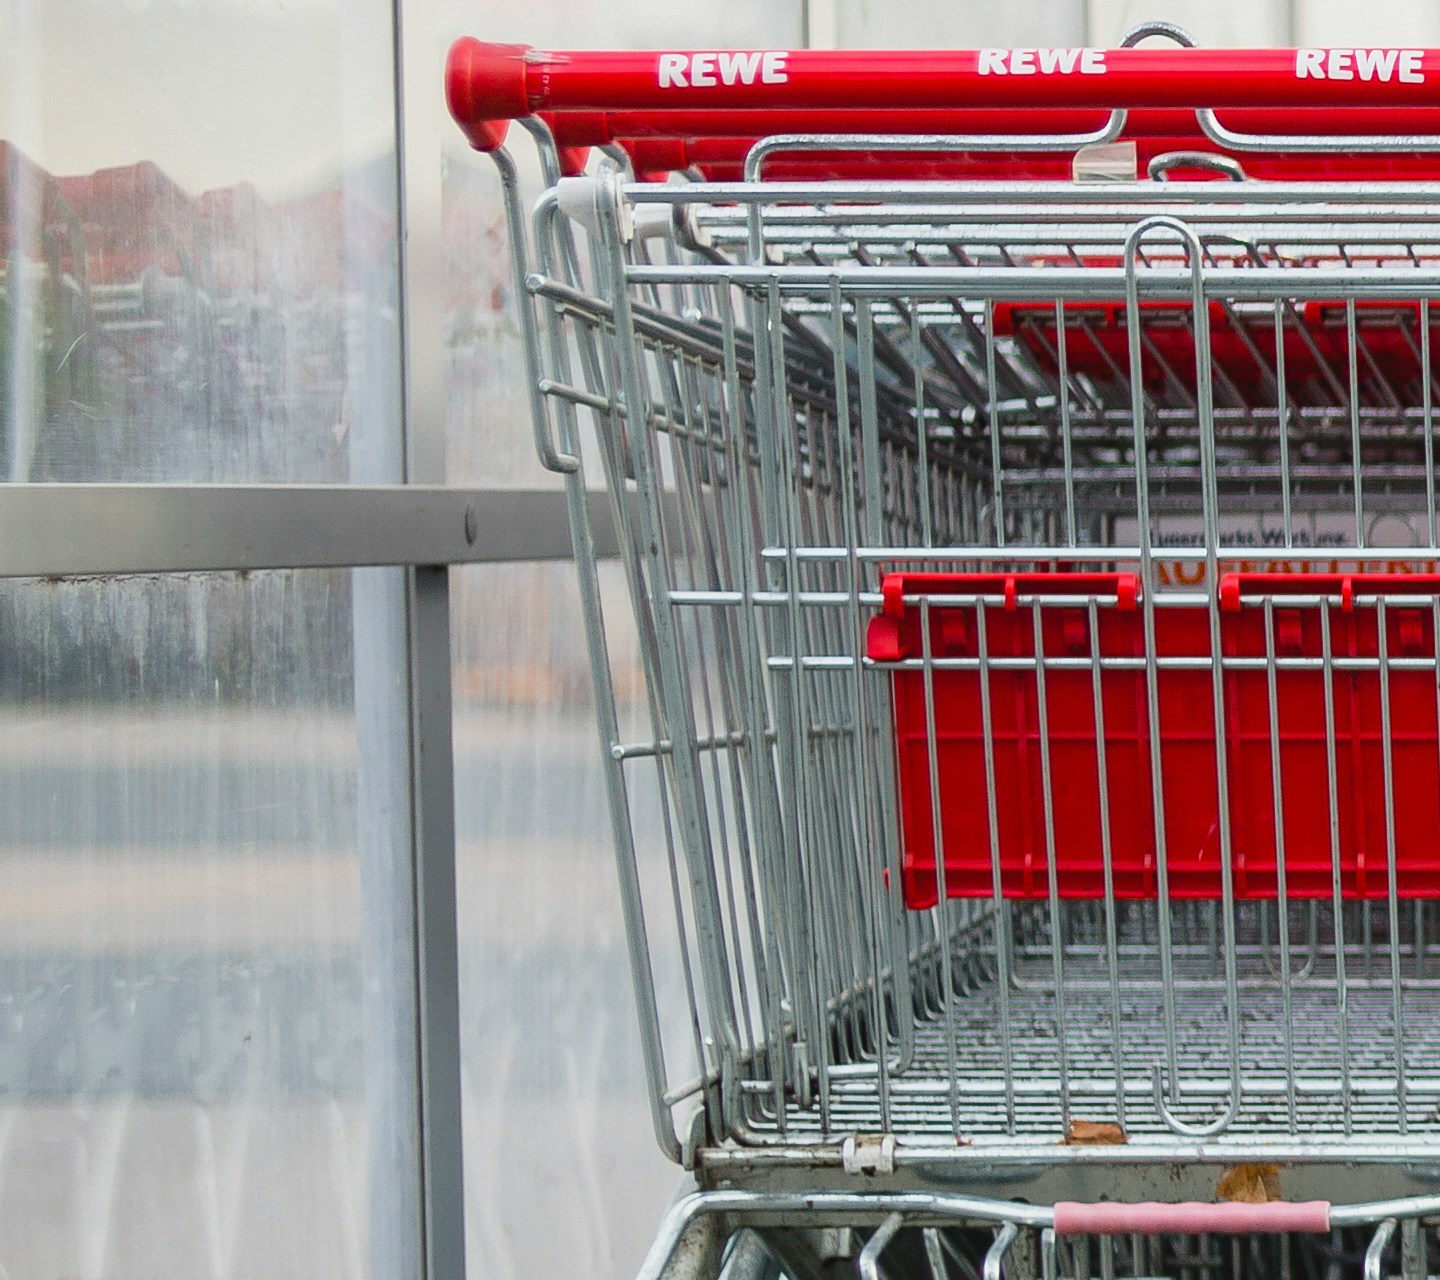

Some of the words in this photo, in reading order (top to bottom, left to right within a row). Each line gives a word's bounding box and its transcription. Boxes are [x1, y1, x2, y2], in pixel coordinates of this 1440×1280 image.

[657, 51, 789, 88] REWE
[977, 48, 1108, 75] REWE
[1296, 49, 1426, 84] REWE
